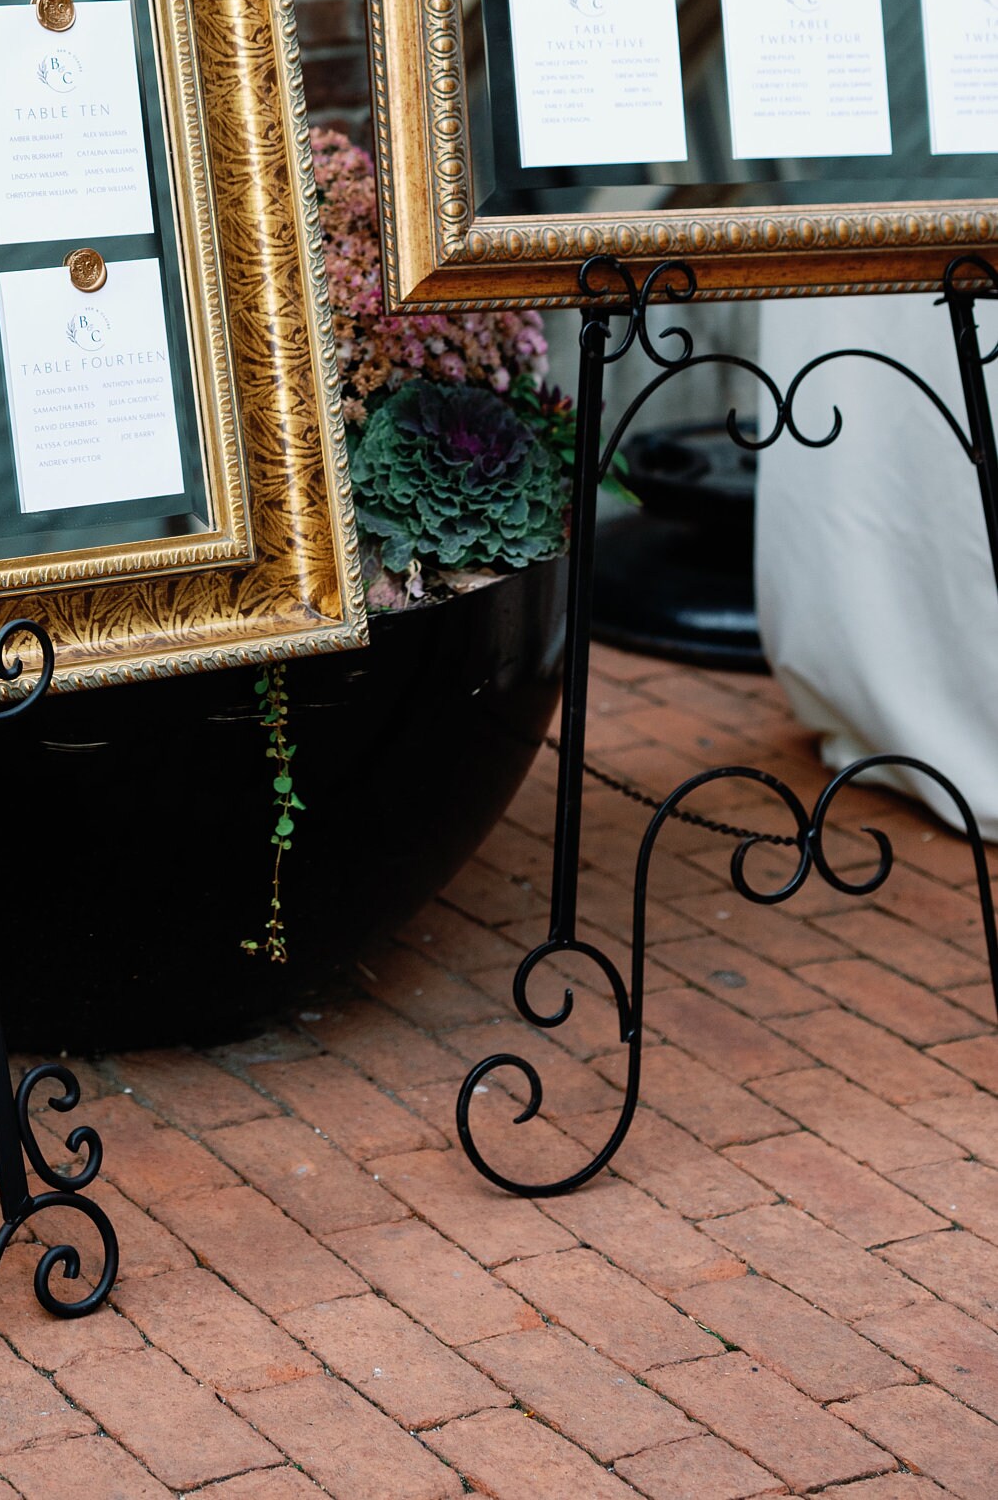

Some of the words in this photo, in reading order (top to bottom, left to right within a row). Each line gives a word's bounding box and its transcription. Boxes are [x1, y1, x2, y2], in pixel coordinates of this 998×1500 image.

[14, 105, 67, 121] TABLE
[79, 102, 110, 117] TEN
[21, 359, 70, 376] TABLE
[81, 349, 167, 370] FOURTEEN
[34, 422, 58, 433] DAVID
[58, 418, 98, 430] DESENBERG
[38, 457, 69, 468] ANDREW
[69, 453, 102, 464] SPECTOR
